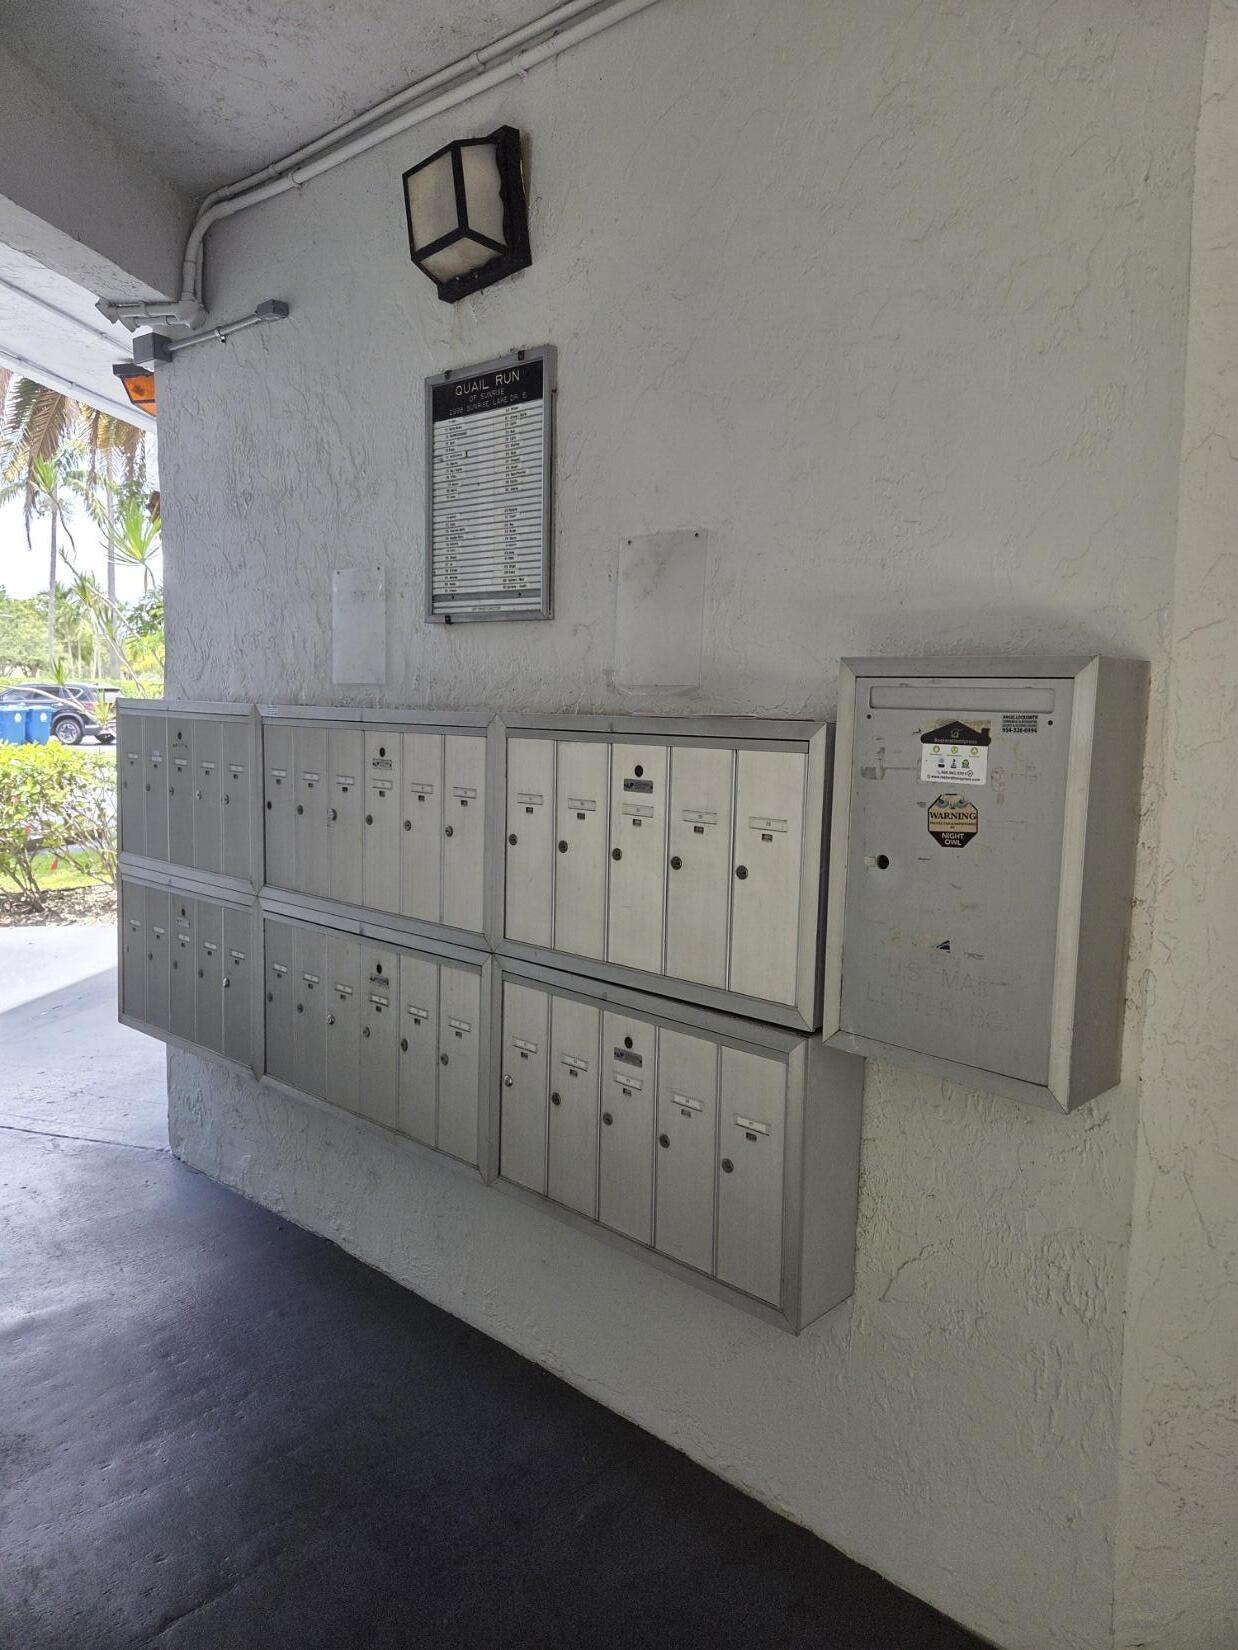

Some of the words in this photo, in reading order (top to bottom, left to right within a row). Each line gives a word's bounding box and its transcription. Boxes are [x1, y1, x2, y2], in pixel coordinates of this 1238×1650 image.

[455, 379, 489, 395] QUAIL
[495, 370, 520, 386] RUN
[930, 812, 976, 820] WARNING
